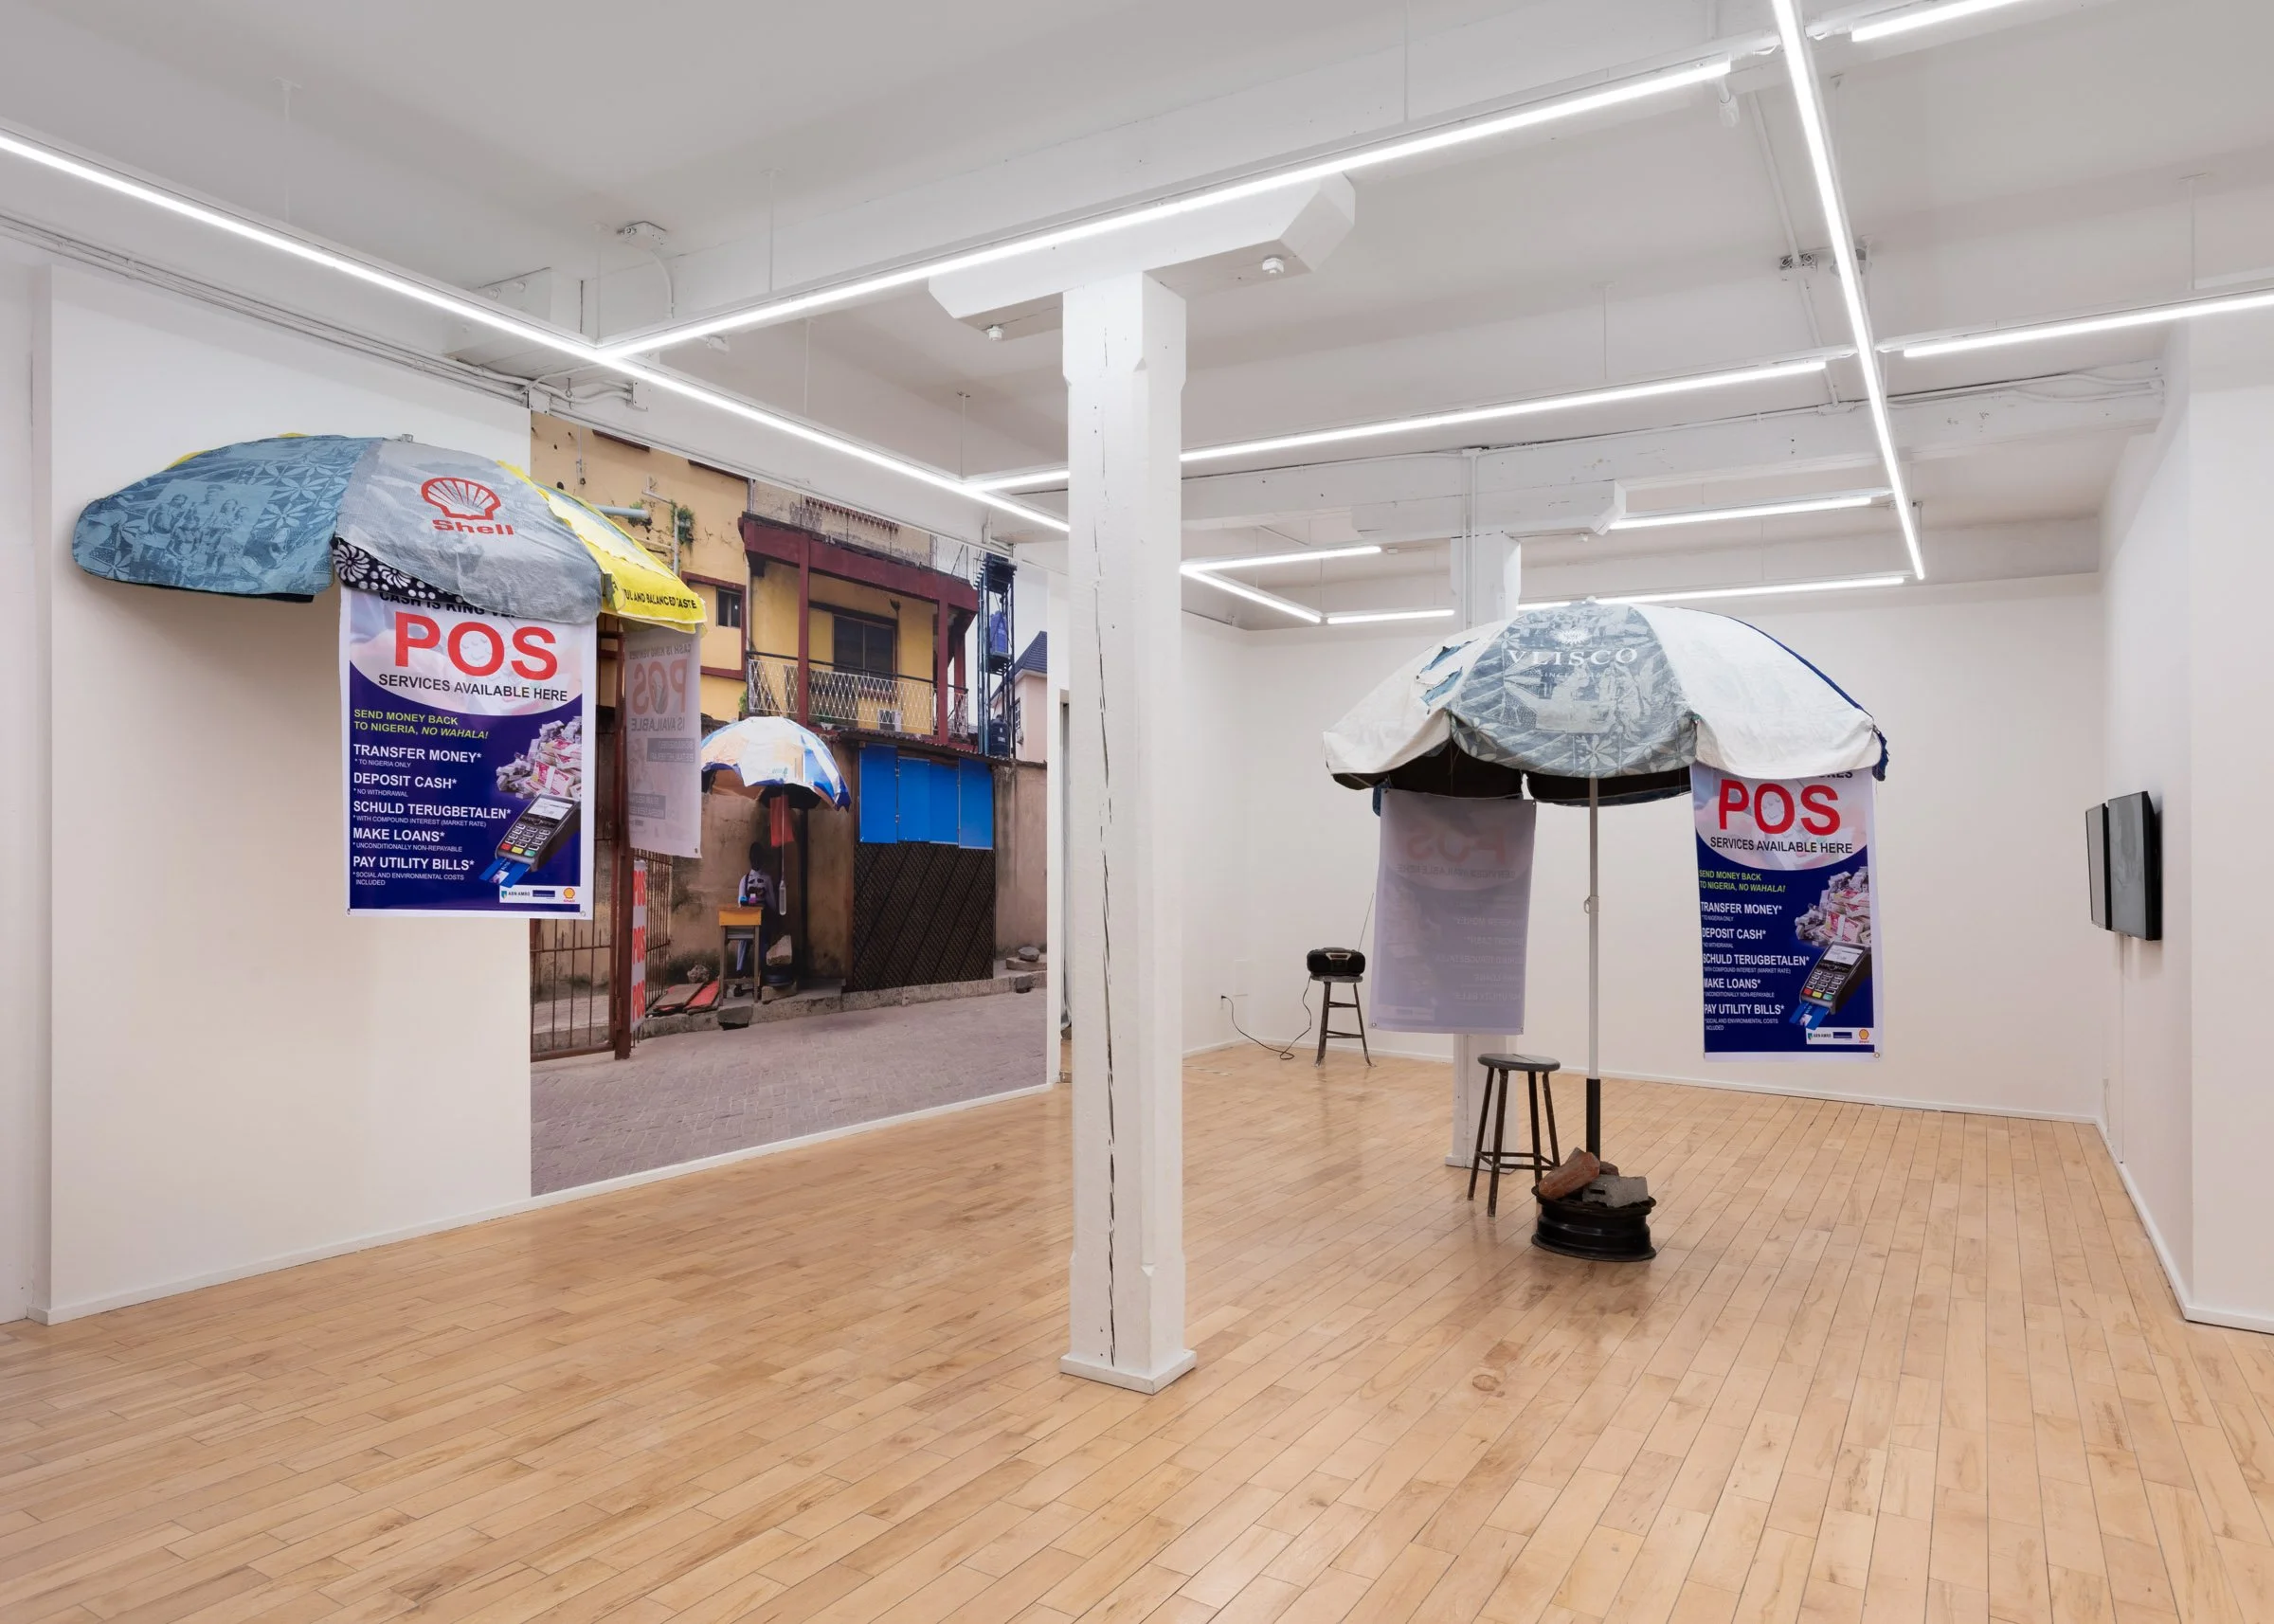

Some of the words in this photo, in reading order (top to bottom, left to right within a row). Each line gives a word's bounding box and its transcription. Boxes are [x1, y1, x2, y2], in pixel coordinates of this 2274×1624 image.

[432, 519, 514, 535] Shell
[634, 592, 646, 603] AND
[646, 594, 676, 606] BALANCED
[395, 611, 558, 681] POS
[1508, 647, 1639, 665] VLISCO
[379, 674, 451, 693] SERVICES
[454, 681, 531, 698] AVAILABLE
[533, 688, 568, 702] HERE
[353, 709, 384, 720] SEND
[387, 712, 425, 723] MONEY
[428, 715, 459, 726] BACK
[353, 720, 369, 731] TO
[370, 722, 419, 735] NIGERIA,
[422, 726, 439, 735] NO
[441, 728, 489, 739] WAHALA!
[353, 744, 425, 760] TRANSFER
[369, 759, 394, 767] NIGERIA
[353, 772, 411, 786] DEPOSIT
[367, 789, 409, 798] WITHDRAWAL
[353, 800, 405, 815] SCHULD
[1718, 779, 1841, 836] POS
[352, 827, 390, 839] MAKE
[412, 844, 463, 853] NON-REPAYABLE
[1710, 837, 1754, 850] SERVICES
[1757, 840, 1817, 853] AVAILABLE
[1820, 842, 1852, 854] HERE
[352, 856, 376, 868] PAY
[380, 857, 429, 870] UTILITY
[1699, 869, 1715, 878] SEND
[1716, 871, 1741, 879] MONEY
[1742, 872, 1761, 881] BACK
[633, 870, 645, 907] POS
[1699, 880, 1707, 889] TO
[1707, 881, 1738, 892] NIGERIA,
[1750, 884, 1786, 893] WAHALA!
[1701, 901, 1742, 913] TRANSFER
[632, 926, 645, 965] POS
[1703, 953, 1732, 965] SCHULD
[632, 979, 645, 1022] POS
[1719, 1004, 1752, 1015] UTILITY
